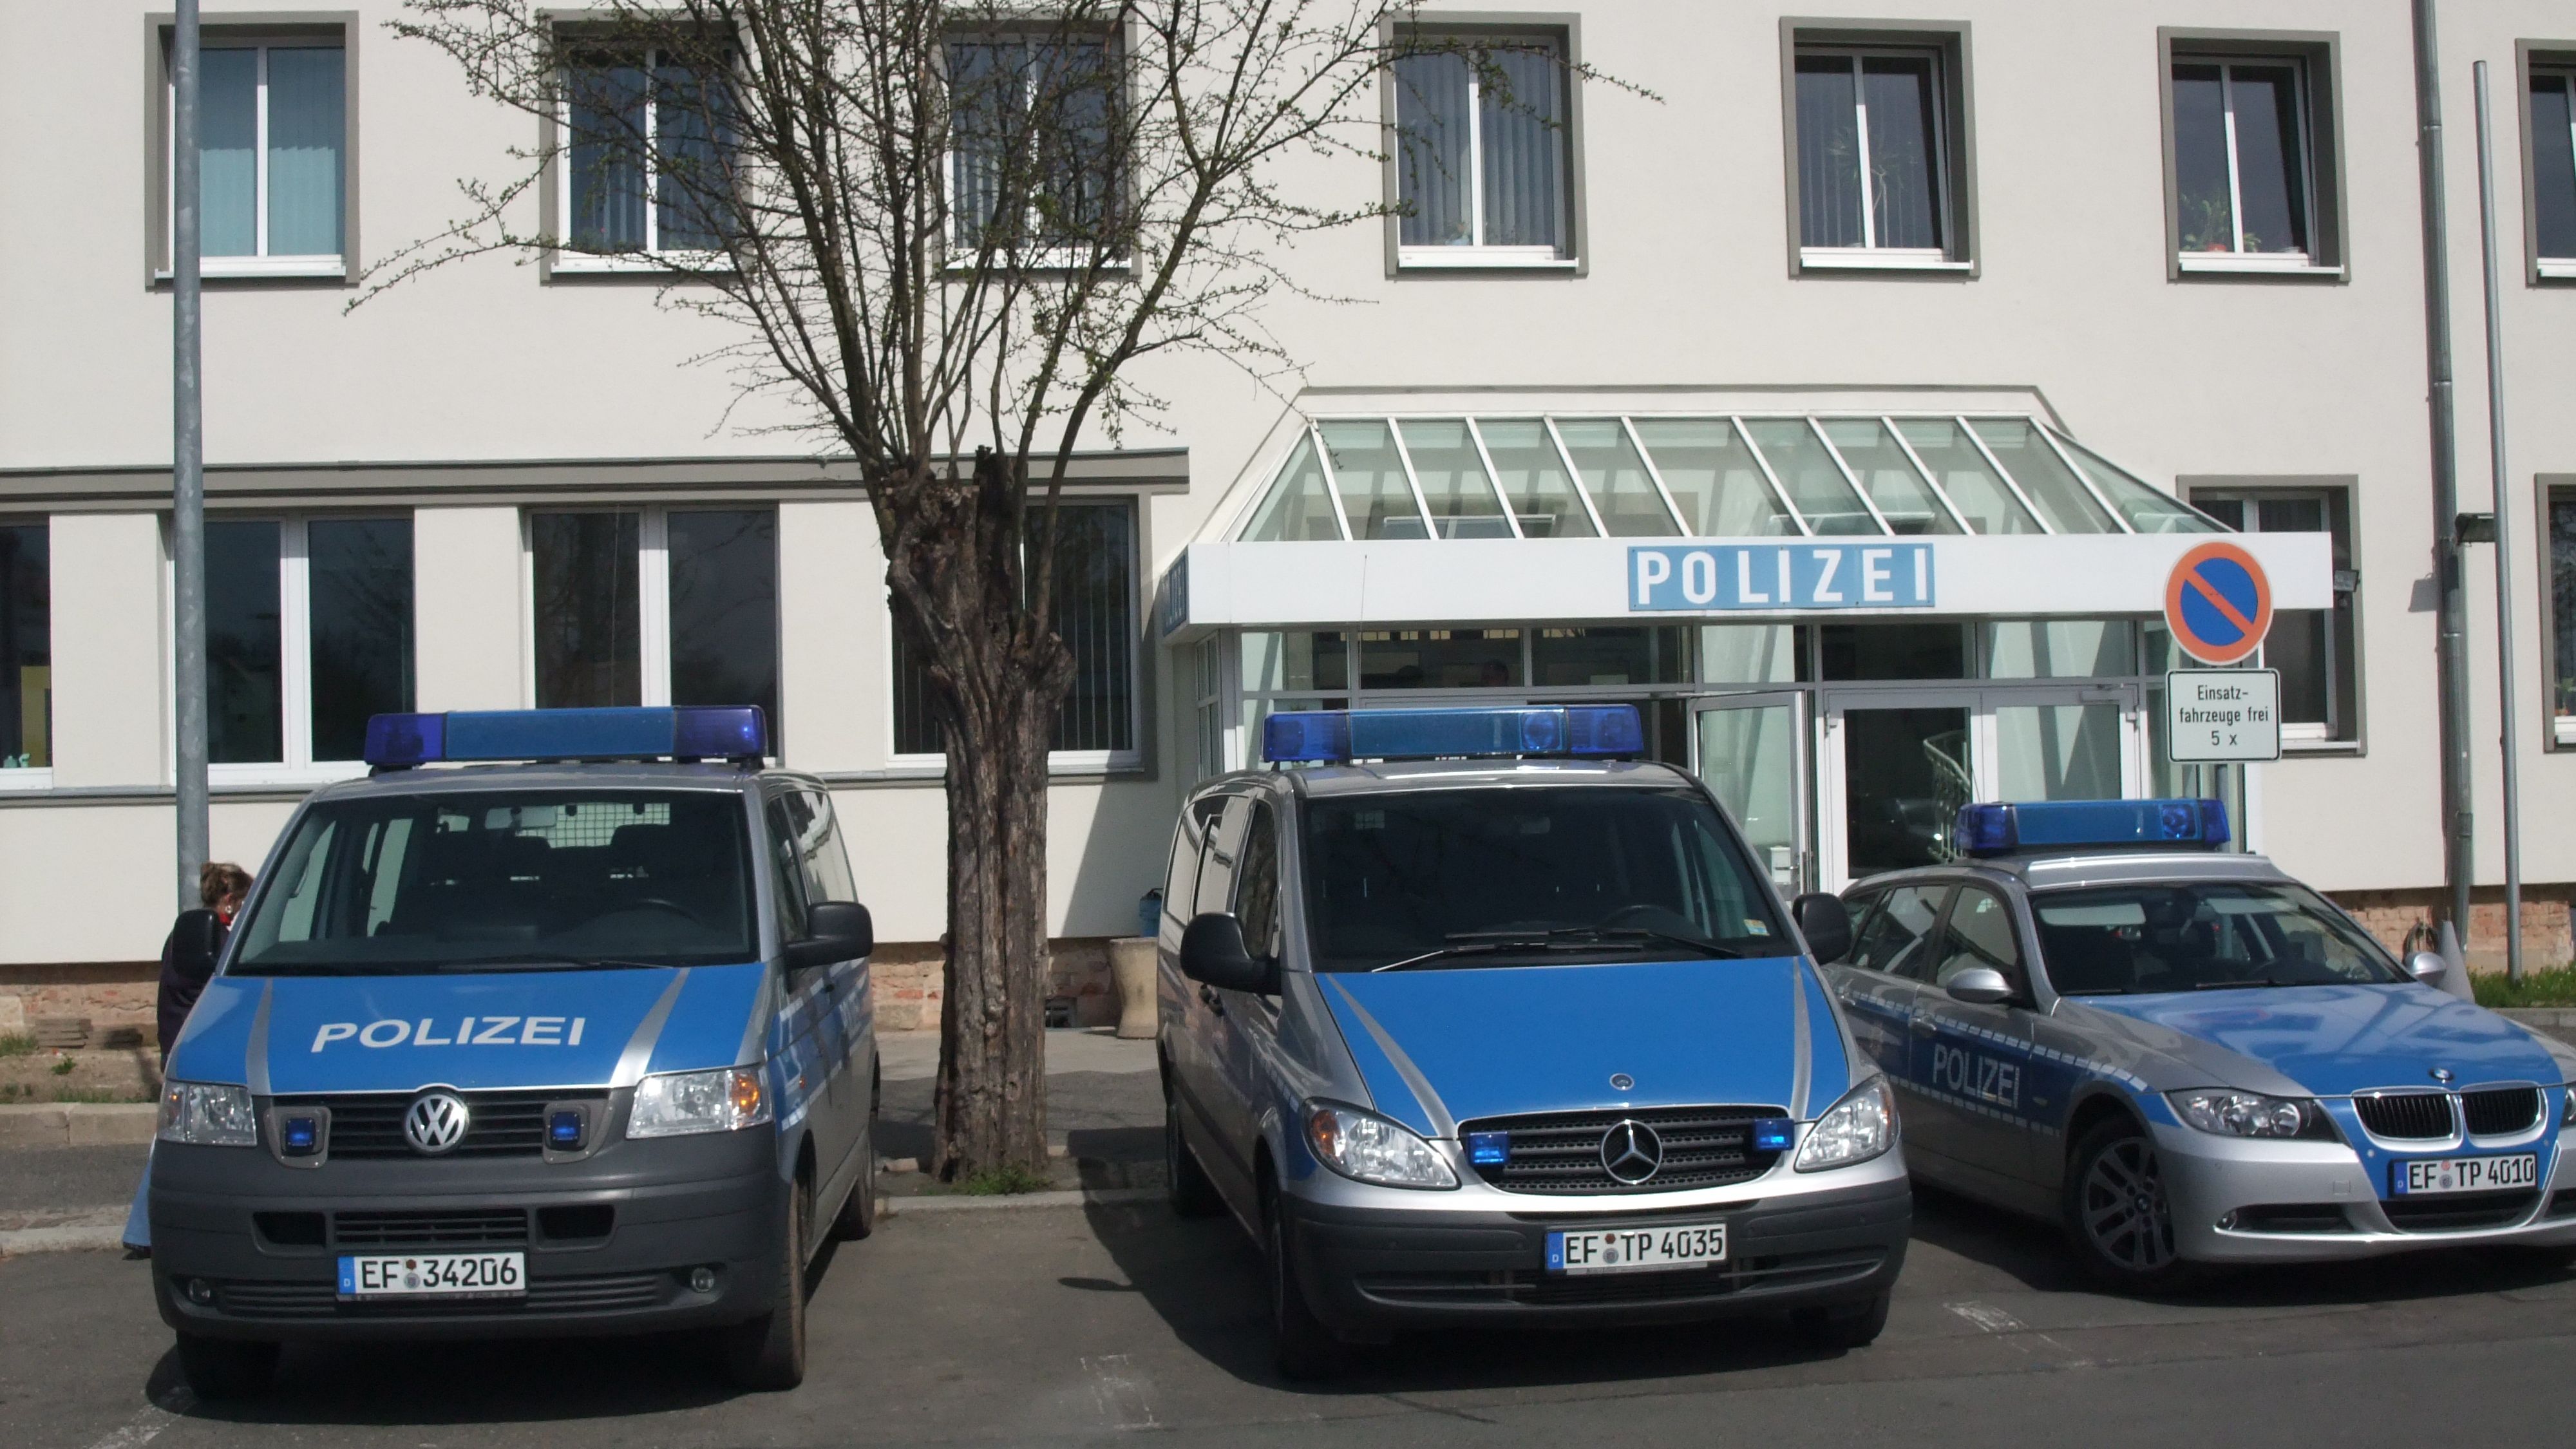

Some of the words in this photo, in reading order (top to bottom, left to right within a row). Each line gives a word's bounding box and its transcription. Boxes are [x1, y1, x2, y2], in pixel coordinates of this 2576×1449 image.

[1637, 548, 1927, 605] POLIZEI
[2197, 685, 2249, 701] Einsatz-
[2179, 707, 2240, 726] fahrzeuge
[2248, 706, 2268, 722] frei
[2211, 730, 2220, 746] 5
[2229, 734, 2238, 745] x
[311, 1016, 585, 1053] POLIZEI
[1933, 1043, 2020, 1109] POLIZEI
[2409, 1163, 2437, 1189] EF
[2455, 1161, 2481, 1186] TP
[2488, 1158, 2534, 1185] 4010
[1566, 1235, 1598, 1264] EF
[1620, 1233, 1653, 1261] TP
[1661, 1228, 1723, 1259] 4035
[361, 1260, 399, 1288] EF
[422, 1257, 517, 1287] 34206
